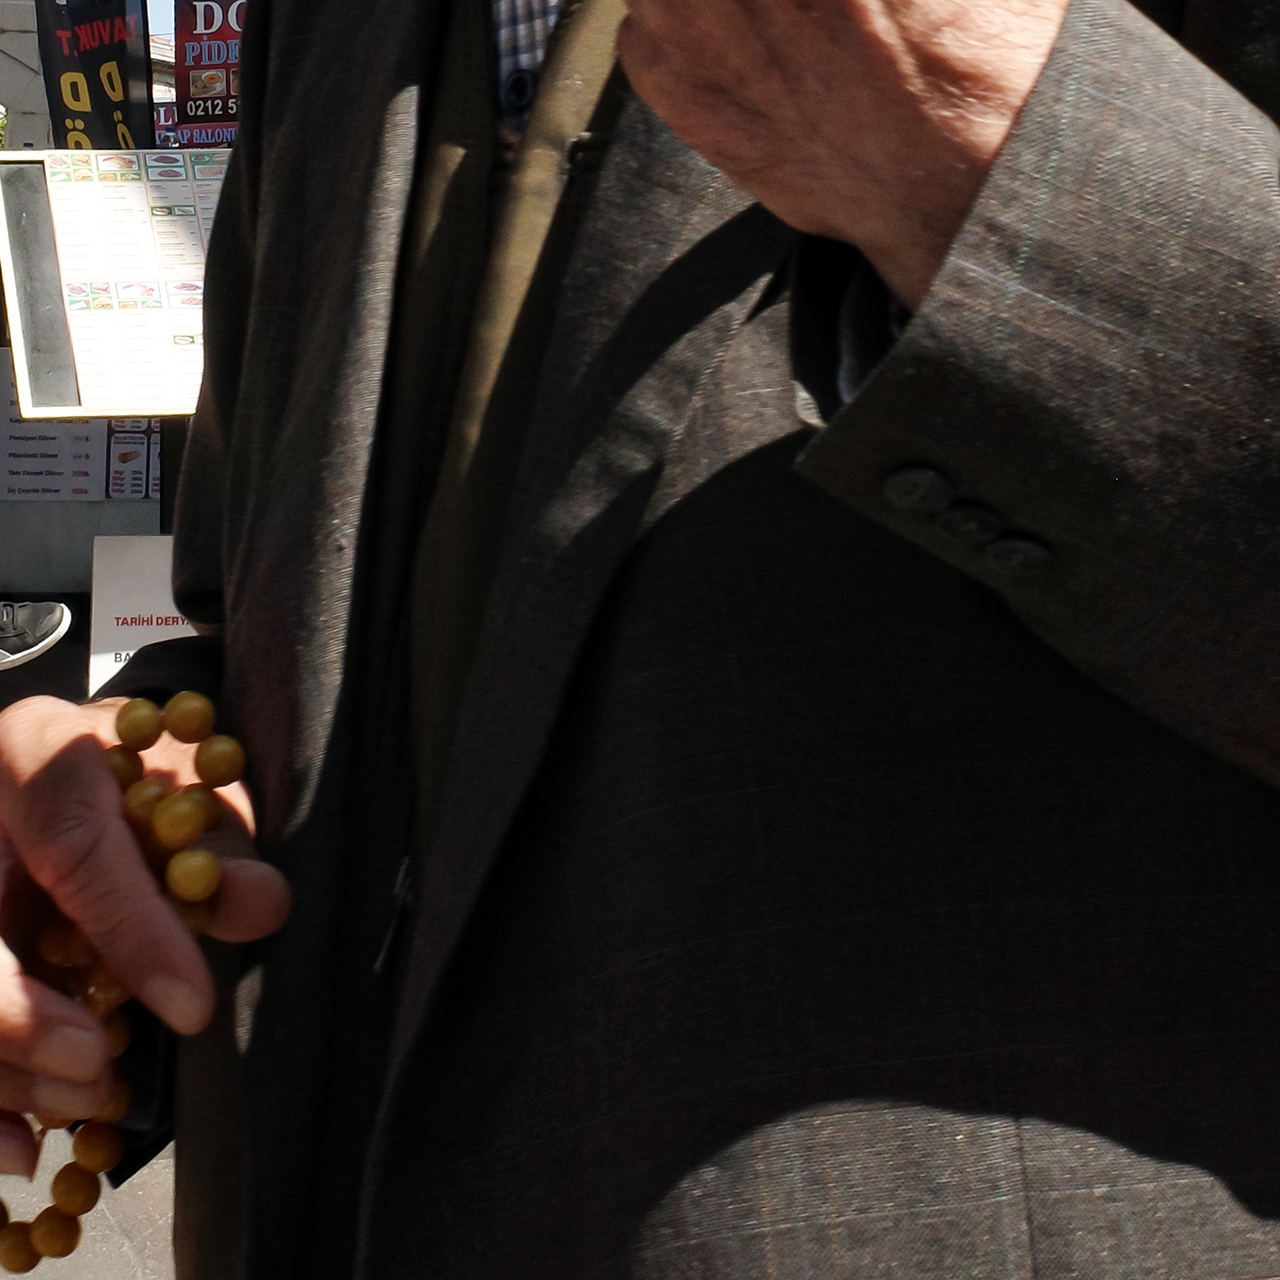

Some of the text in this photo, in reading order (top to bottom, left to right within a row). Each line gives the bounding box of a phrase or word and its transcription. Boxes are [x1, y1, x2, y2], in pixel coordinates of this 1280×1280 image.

[186, 98, 223, 116] 0212
[228, 98, 240, 114] 5
[114, 614, 153, 626] TARİHİ
